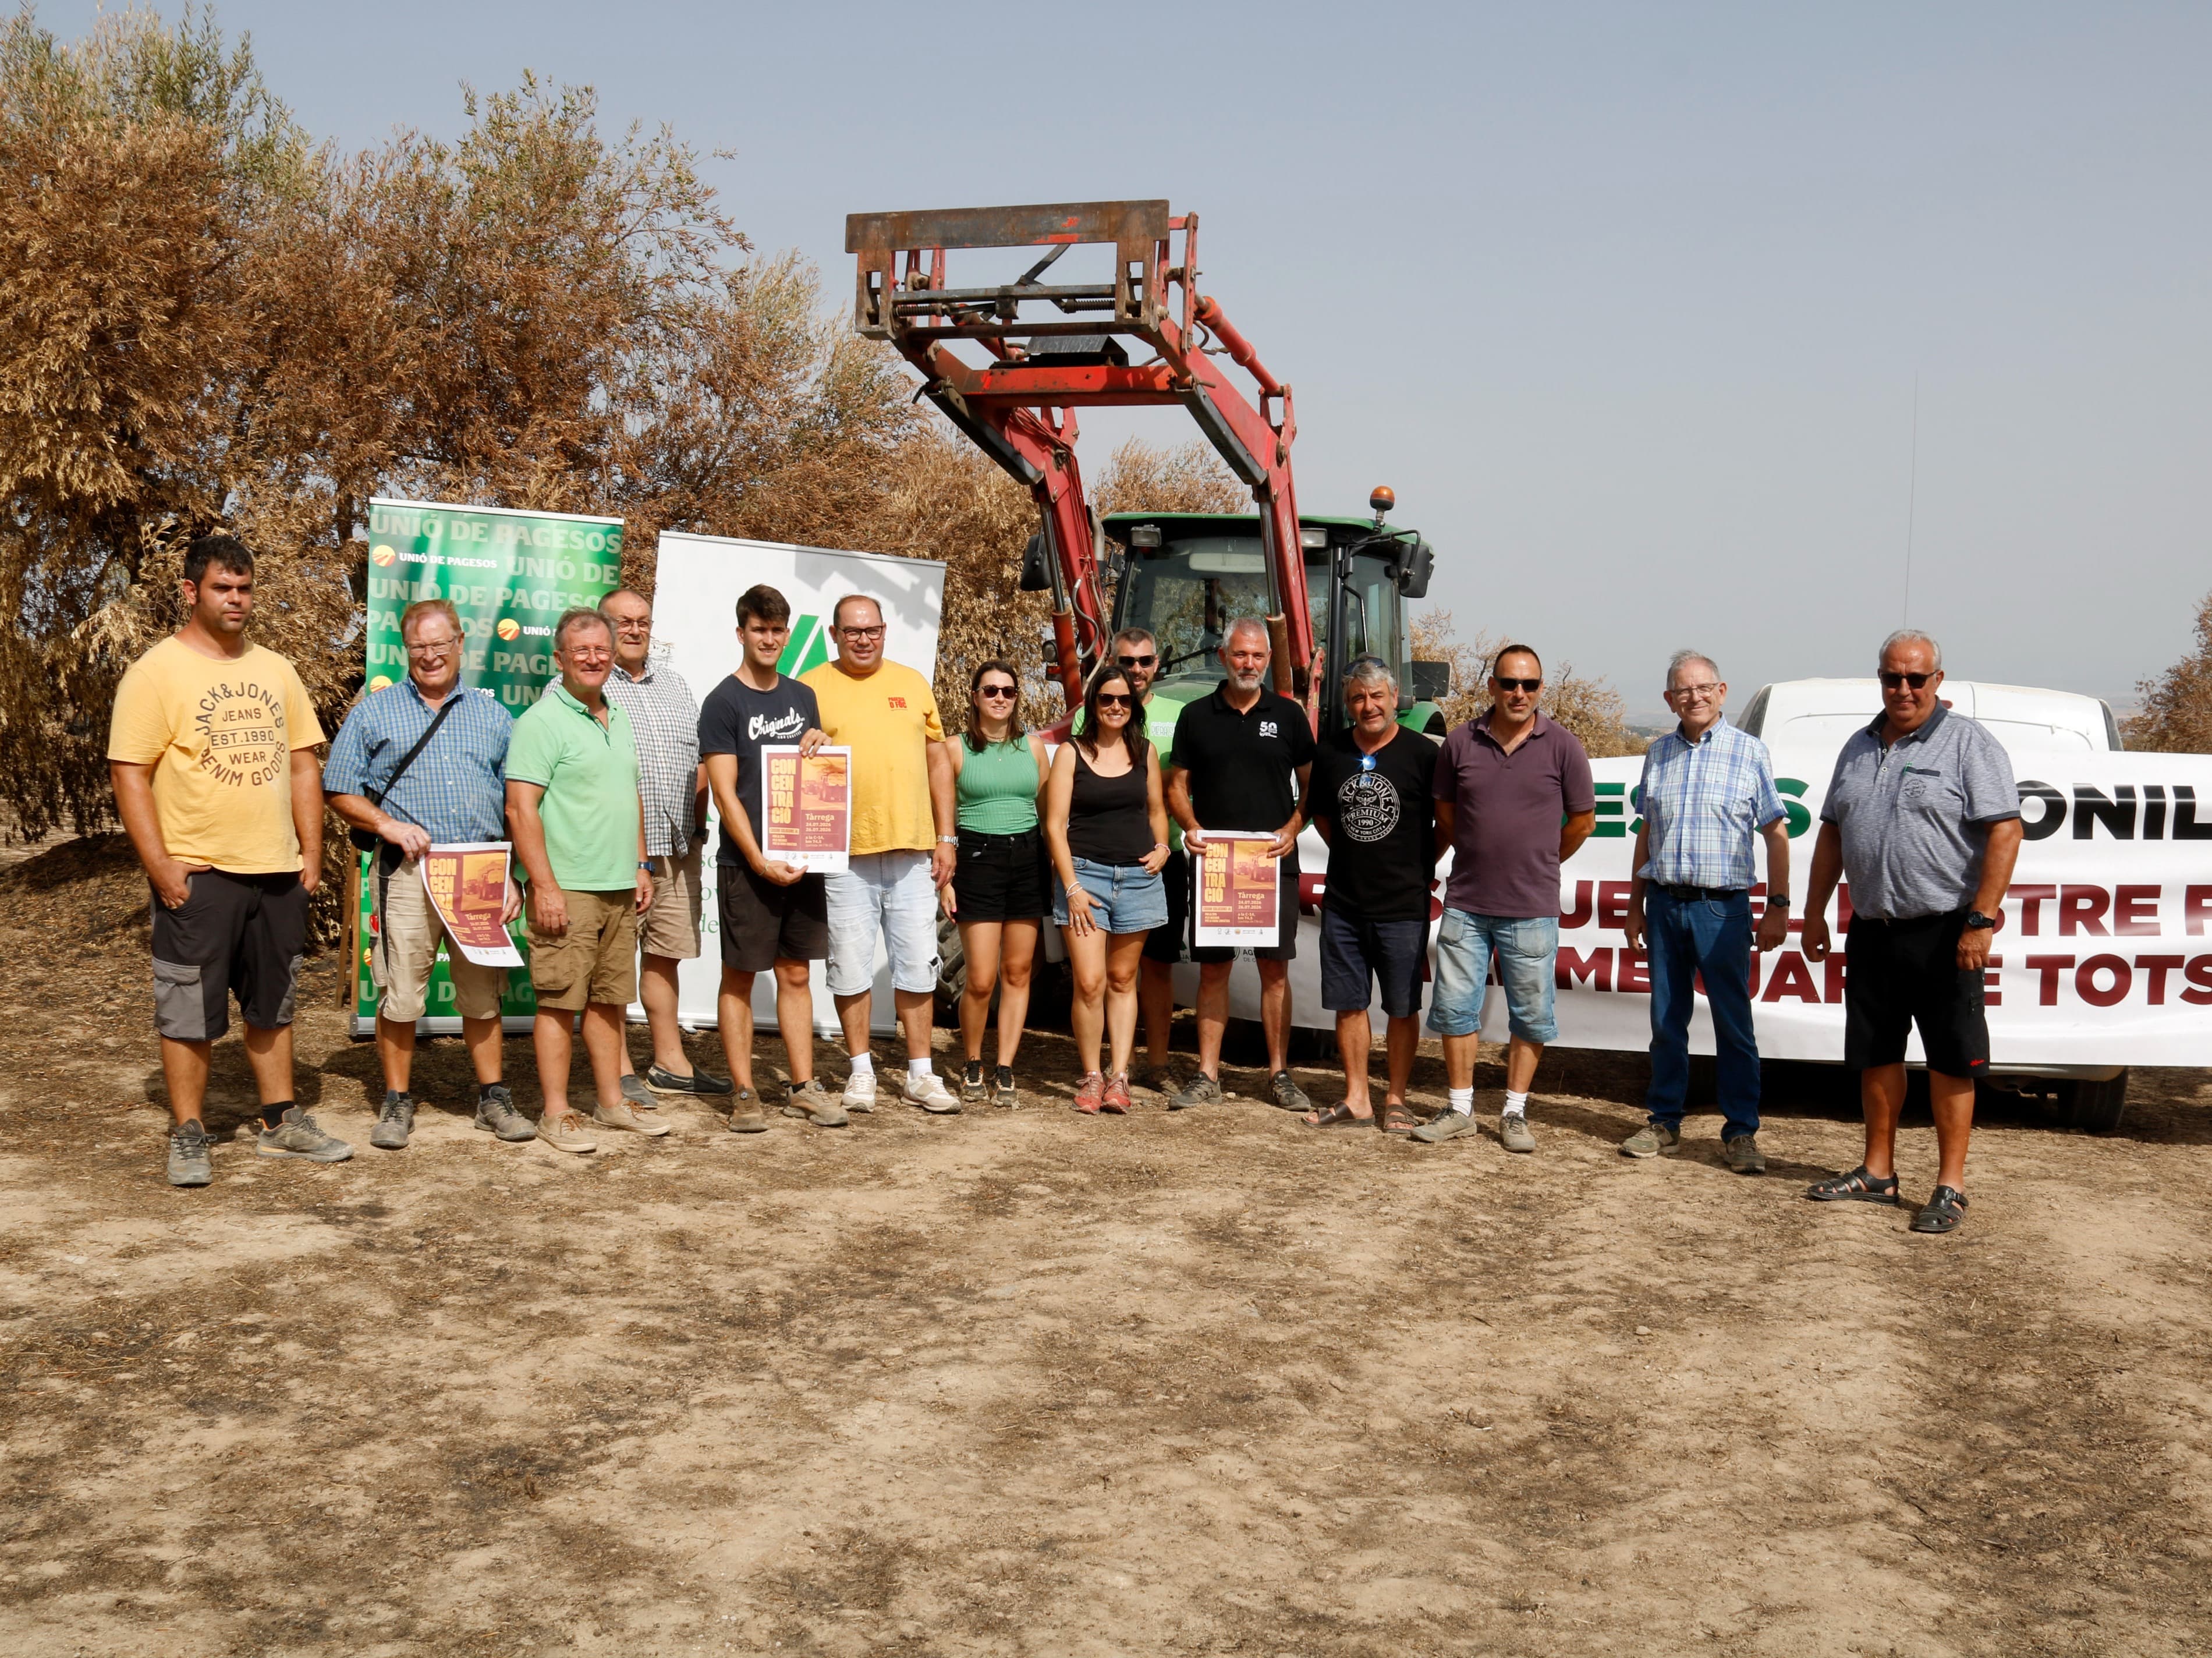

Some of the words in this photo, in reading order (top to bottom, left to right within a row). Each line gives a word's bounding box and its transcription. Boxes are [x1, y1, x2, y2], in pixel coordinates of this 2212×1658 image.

[370, 513, 444, 539] UNIÓ
[451, 520, 488, 543] DE
[497, 524, 621, 554] PAGESOS
[399, 552, 428, 564] UNIÓ
[430, 555, 445, 565] DE
[447, 557, 497, 568] PAGESOS
[506, 556, 576, 580] UNIÓ
[583, 562, 618, 585] DE
[370, 578, 442, 602] UNIÓ
[449, 584, 487, 606] DE
[496, 587, 602, 611] PAGESO
[367, 611, 494, 638] PAOS
[523, 626, 551, 636] UNIÓ
[368, 643, 407, 666] UN
[222, 708, 261, 722] JEANS
[748, 706, 802, 740] Originals
[229, 751, 266, 765] WEAR
[251, 741, 285, 786] GOODS
[771, 759, 796, 775] CON
[771, 775, 794, 791] CEN
[771, 791, 794, 807] TRA
[805, 813, 835, 822] Tàrrega
[1346, 809, 1389, 823] PREMIUM
[2015, 780, 2212, 841] ONIL
[1350, 826, 1359, 834] NEW
[1373, 826, 1383, 834] CITY
[1206, 843, 1228, 858] CON
[429, 858, 457, 876] CON
[1204, 858, 1226, 873] CEN
[429, 876, 455, 893] CEN
[1204, 873, 1226, 888] TRA
[1238, 892, 1265, 900] Tàrrega
